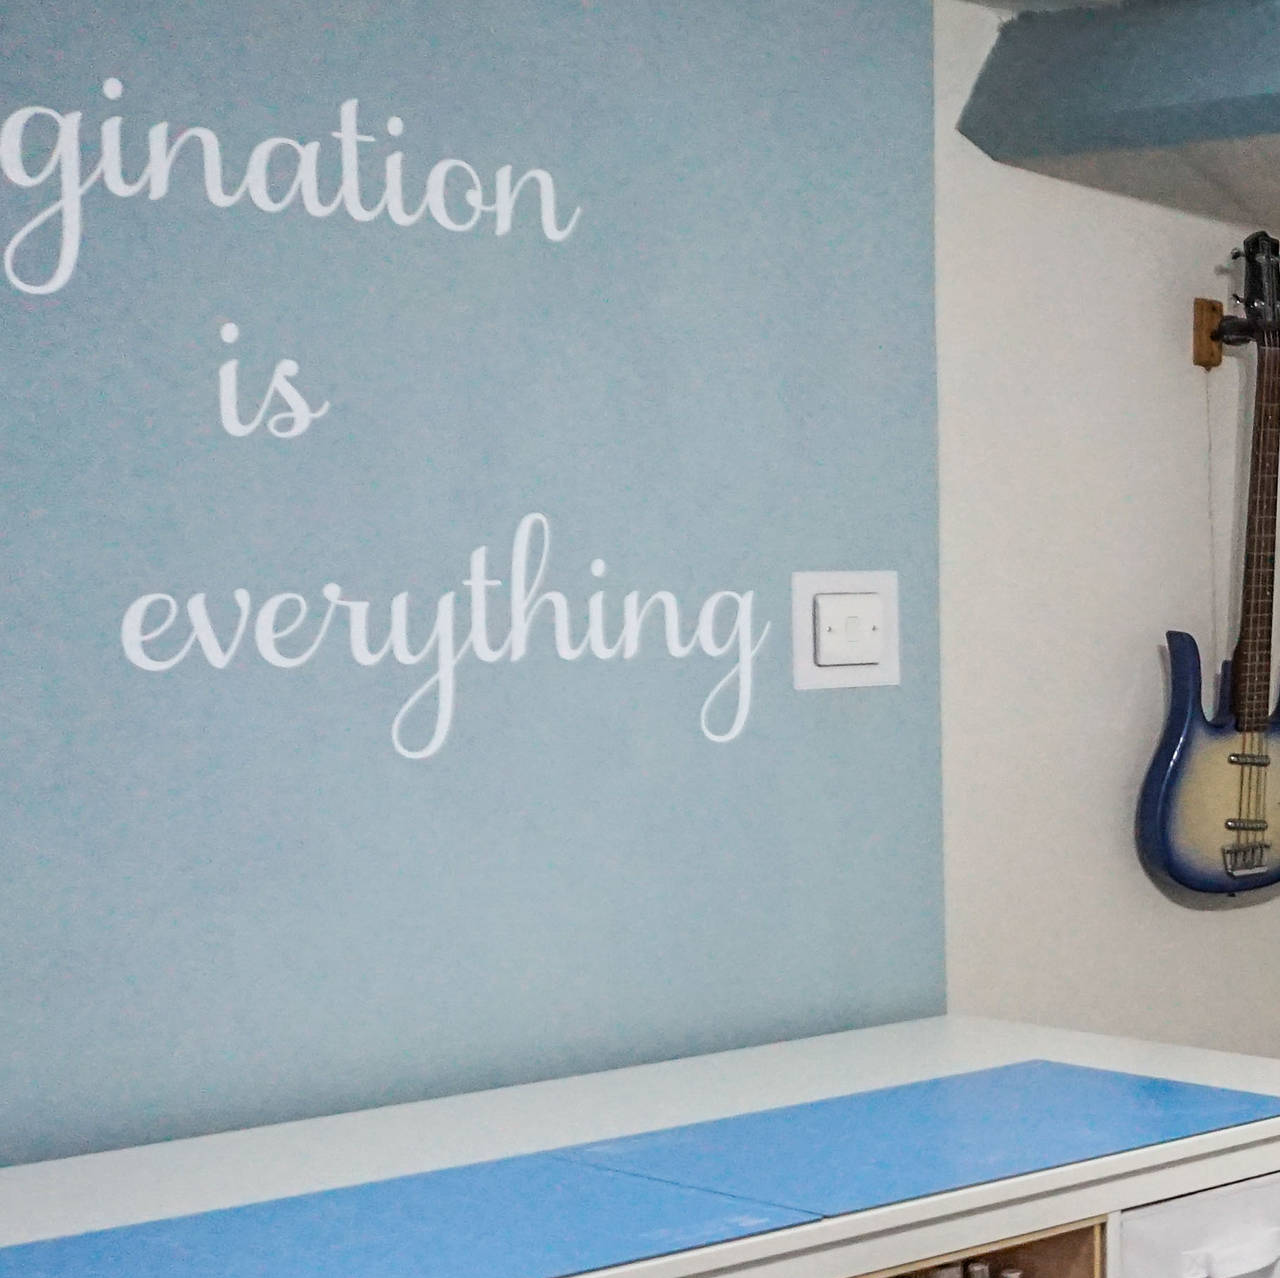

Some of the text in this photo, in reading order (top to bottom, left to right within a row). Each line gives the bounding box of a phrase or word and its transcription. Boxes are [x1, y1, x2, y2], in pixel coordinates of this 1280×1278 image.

[0, 77, 581, 294] gination
[218, 322, 330, 439] is
[121, 512, 771, 760] everything
